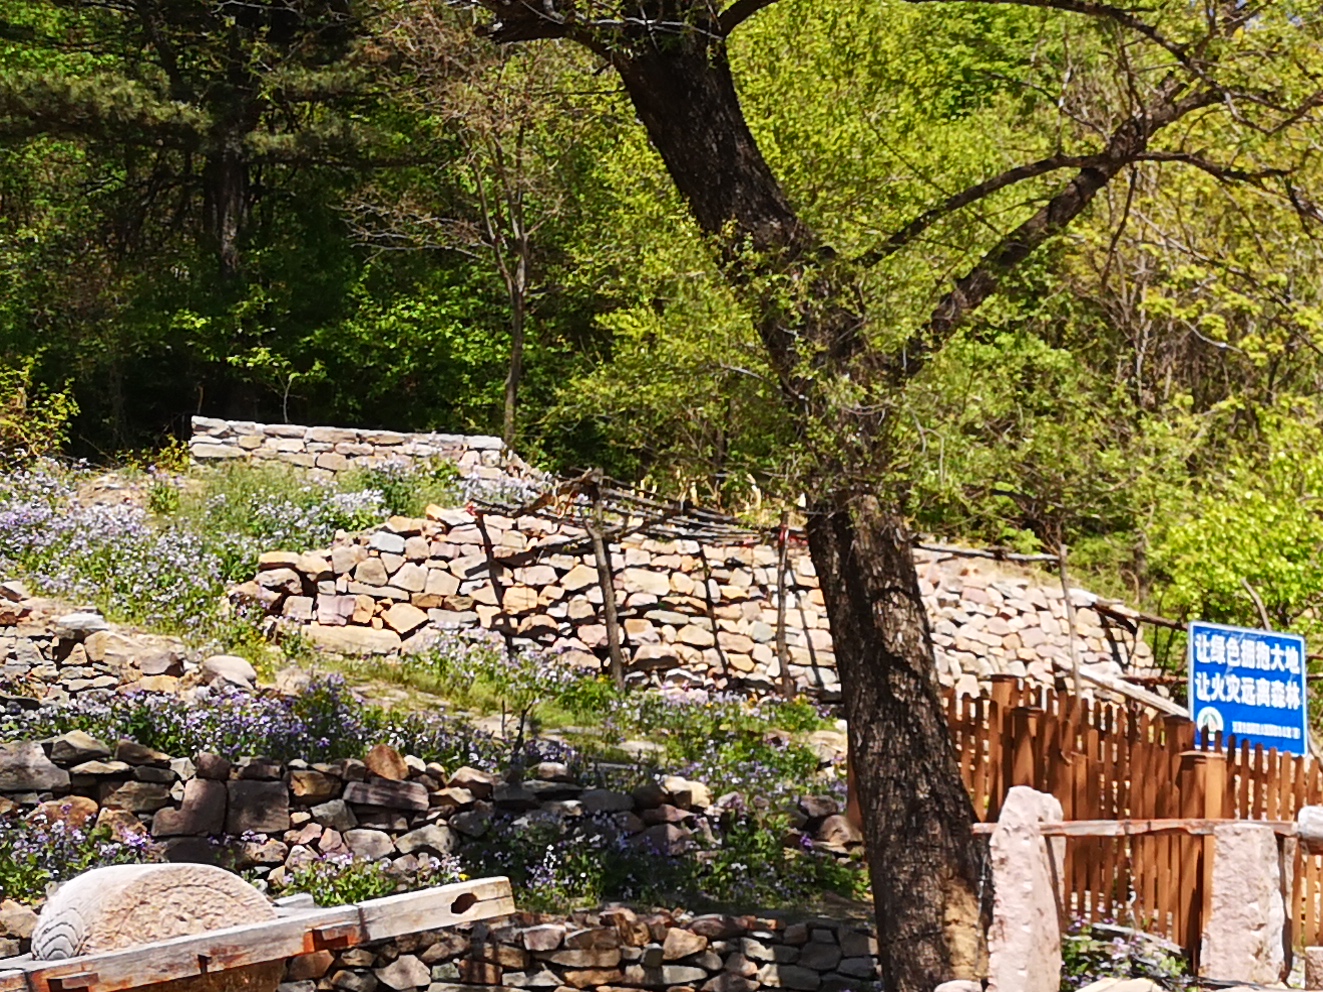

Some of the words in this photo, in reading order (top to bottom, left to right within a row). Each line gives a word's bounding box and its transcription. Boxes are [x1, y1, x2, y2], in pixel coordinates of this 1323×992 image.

[1195, 633, 1300, 674] 让绿色拥抱大地
[1195, 671, 1300, 710] 让火灾远离森林
